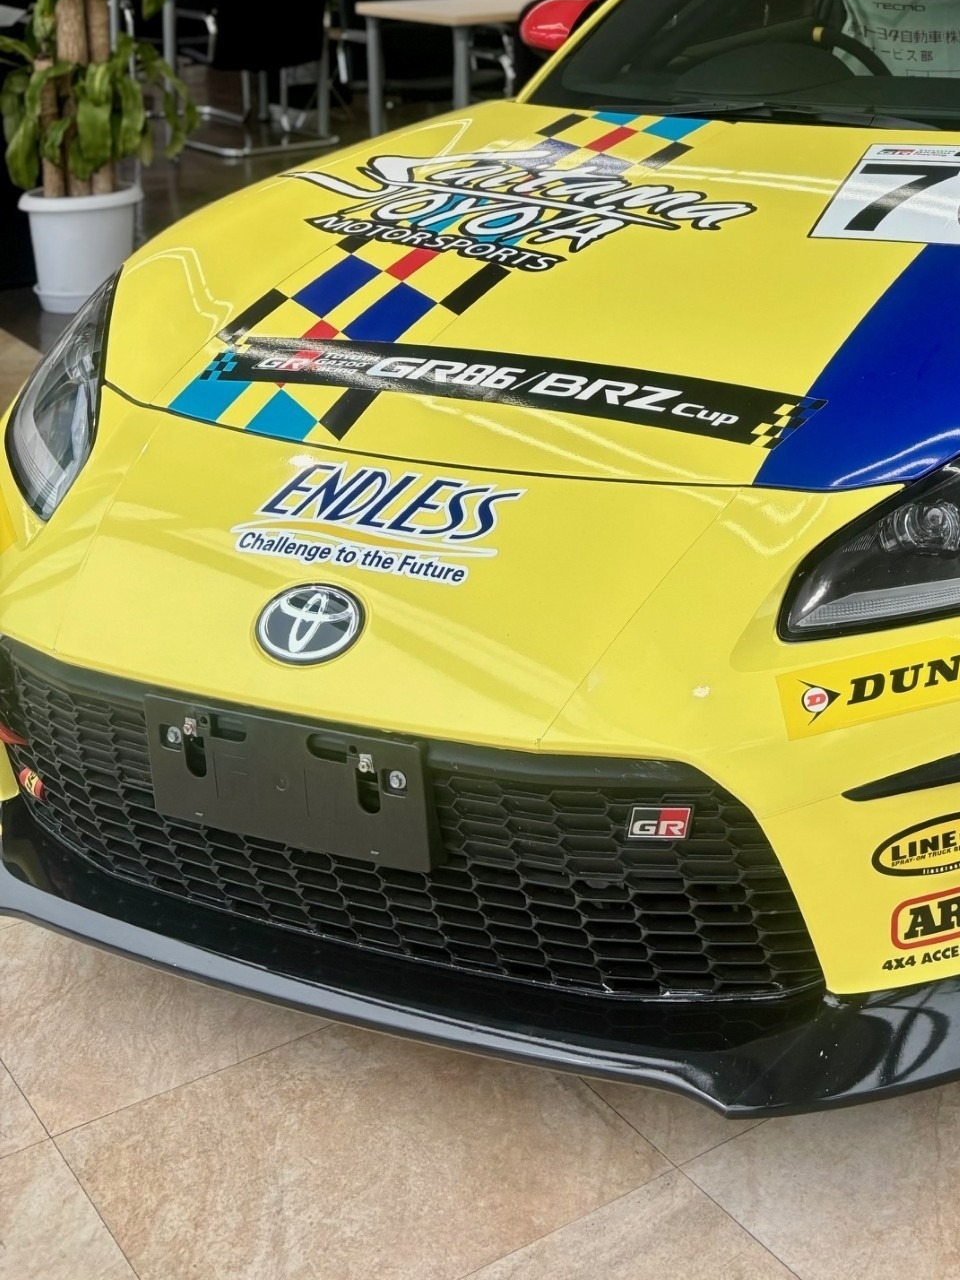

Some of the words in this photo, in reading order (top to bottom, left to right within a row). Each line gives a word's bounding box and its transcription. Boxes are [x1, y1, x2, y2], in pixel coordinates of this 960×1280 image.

[278, 148, 757, 231] Saitama
[312, 214, 560, 271] MOTORSPORTS
[256, 355, 313, 372] GR
[671, 401, 740, 428] Cup
[259, 463, 522, 540] ENDLESS
[238, 531, 332, 562] Challenge
[337, 545, 357, 564] to
[361, 550, 394, 570] the
[399, 555, 466, 583] Future
[632, 820, 685, 835] GR
[891, 853, 926, 868] SPRAY-ON
[928, 847, 952, 859] TRUCK
[881, 955, 917, 971] 4X4
